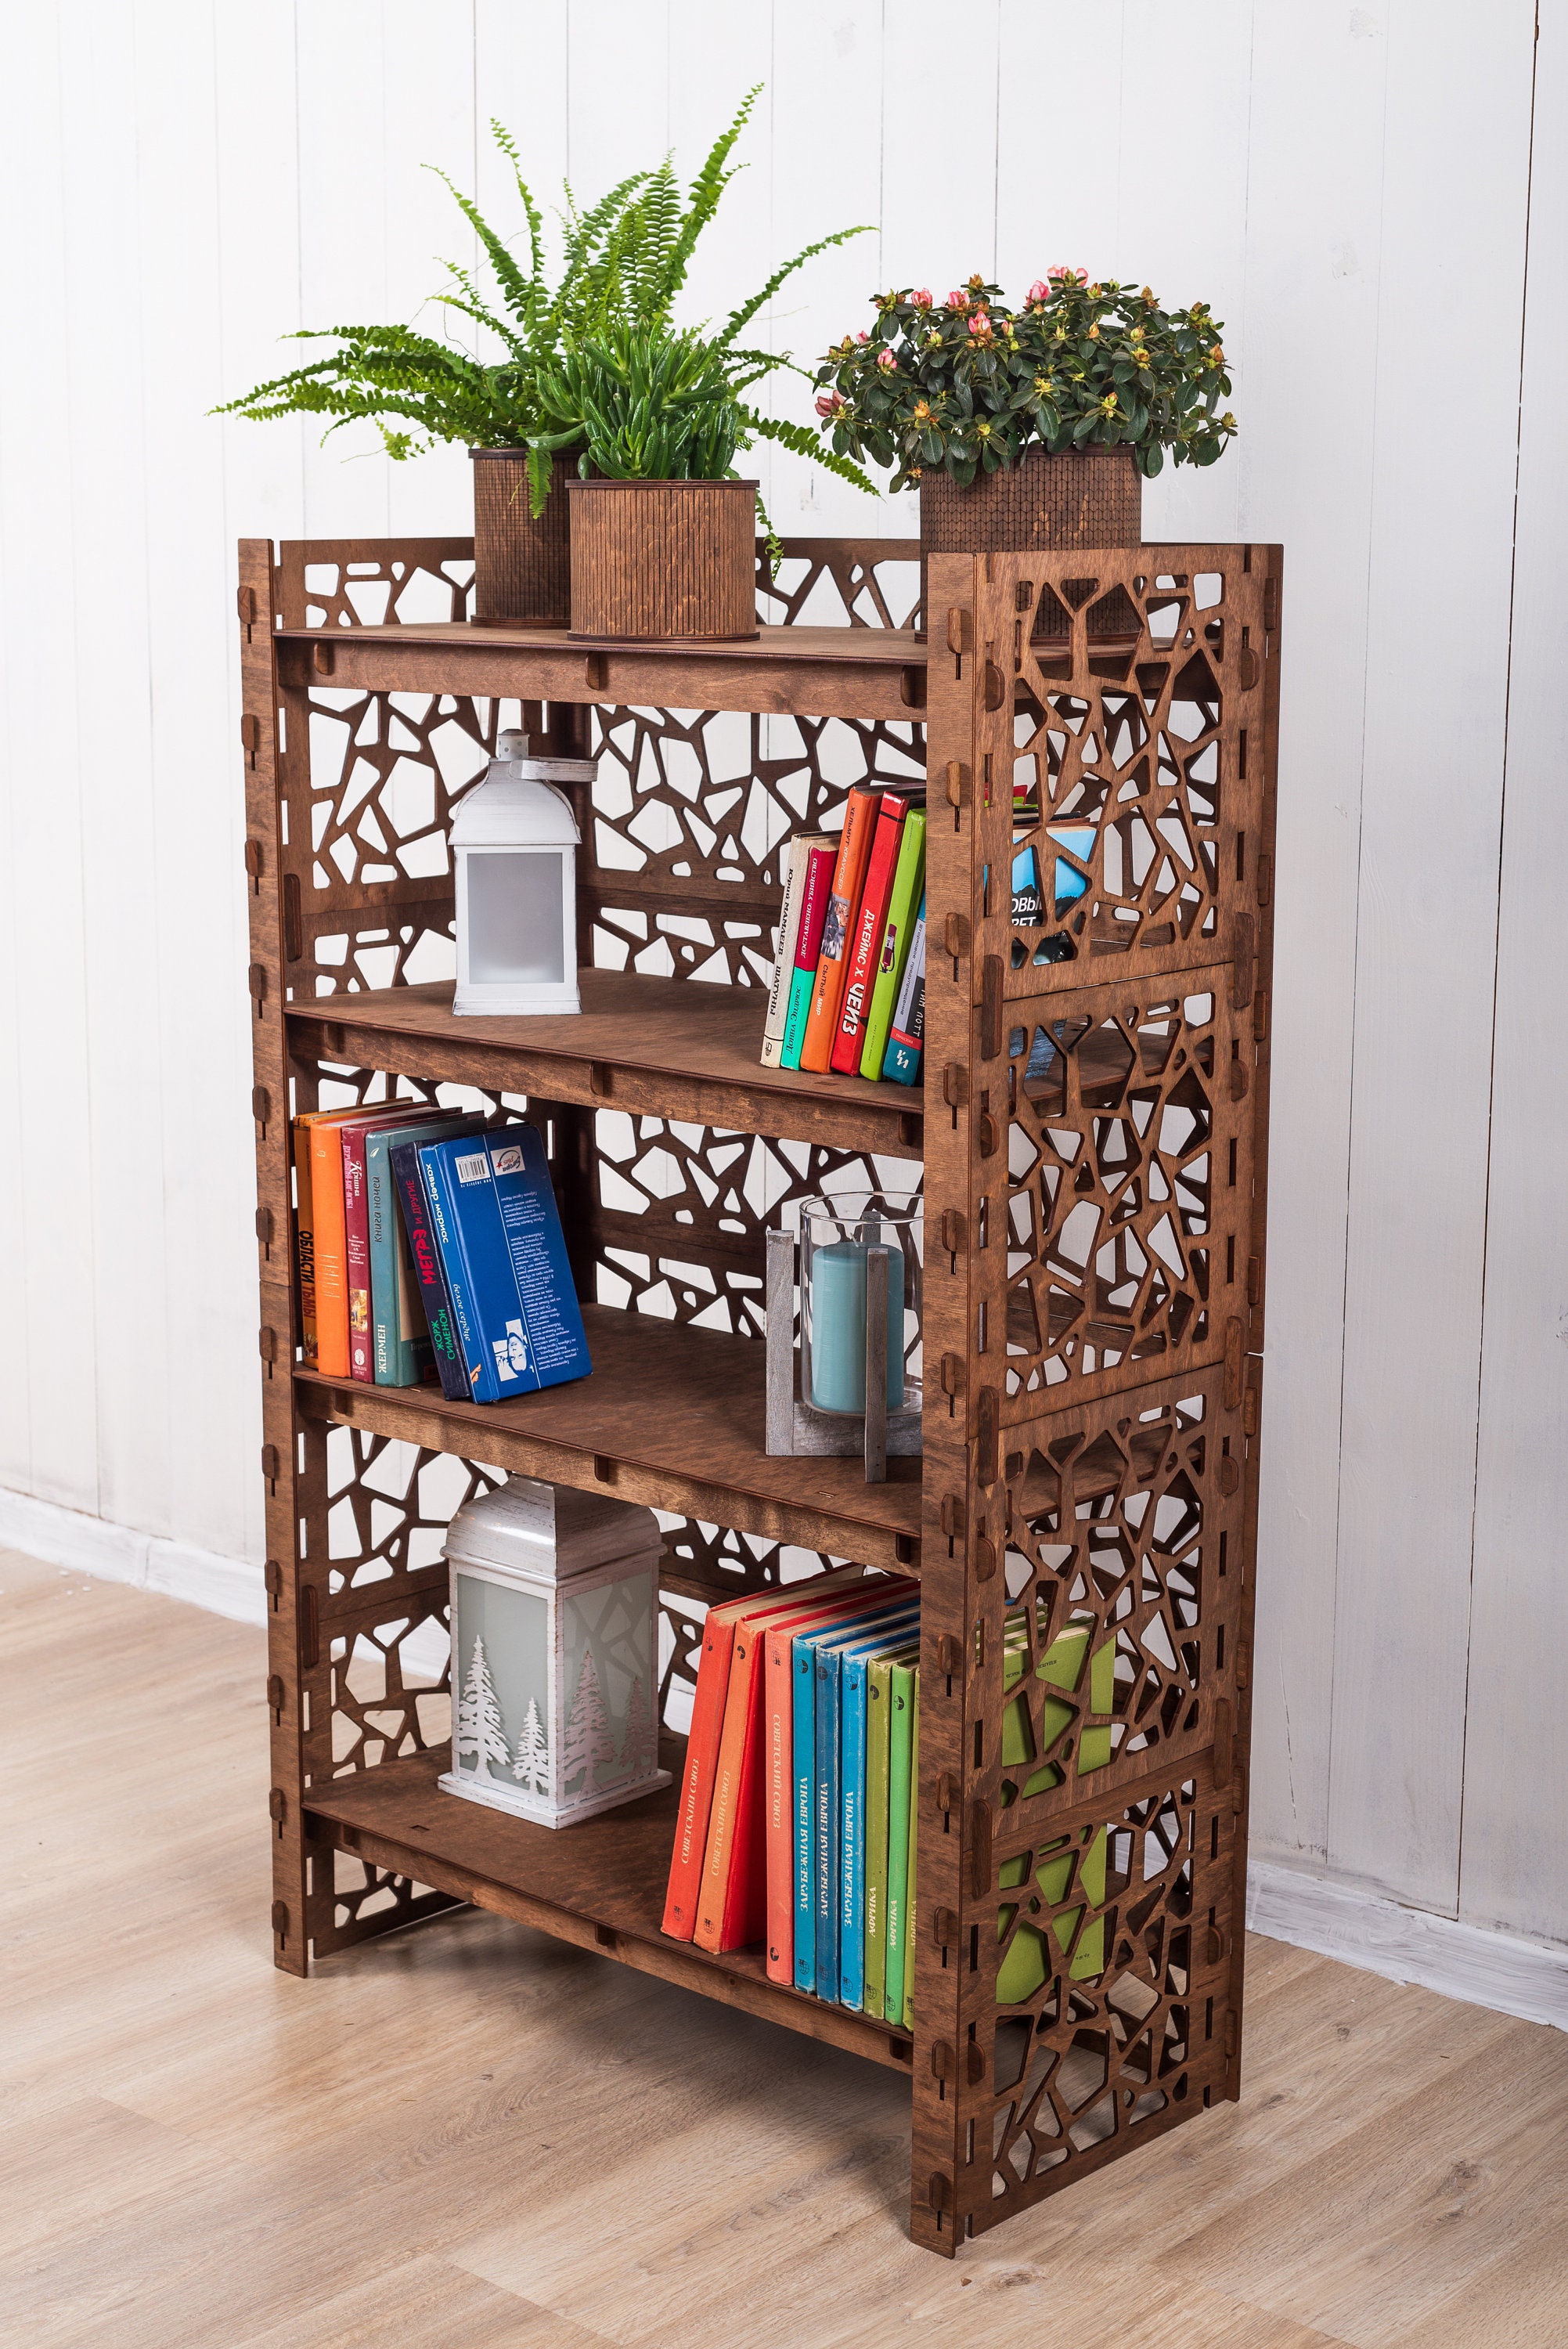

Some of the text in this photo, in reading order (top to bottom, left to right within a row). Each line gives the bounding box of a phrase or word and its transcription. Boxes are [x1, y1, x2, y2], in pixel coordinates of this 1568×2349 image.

[838, 806, 855, 890] ХЕЛЬМУТ КРАУССЕР
[801, 857, 818, 958] ДОСТАВЛЕНО: УБИЙСТВО
[857, 909, 875, 965] ДЖЕЙМС
[770, 868, 794, 1016] Юрий МАМЛЕЕВ ШАТУНЫ
[818, 964, 829, 997] СЫТЫЙ
[900, 962, 914, 1016] предупреждение
[786, 986, 802, 1055] Донна Эндрюс
[913, 1011, 924, 1037] ЛОТТ
[350, 1160, 362, 1196] Крішна
[406, 1180, 422, 1214] ДРУГИЕ
[425, 1164, 449, 1244] хавьер мариас
[299, 1230, 315, 1319] ОБЛАСТИ ТЬМЫ
[413, 1229, 437, 1285] МЕГРЭ
[431, 1320, 445, 1351] ЖОРЖ
[438, 1308, 456, 1360] СИМЕНОН
[452, 1283, 471, 1341] белое сердце
[377, 1324, 387, 1373] ЖЕРМЕН
[773, 1714, 781, 1829] СОВЕТСКИЙ СОЮЗ
[681, 1759, 700, 1864] СОВЕТСКИЙ СОЮЗ
[711, 1807, 726, 1877] СОВЕТСКИЙ
[800, 1777, 809, 1913] ЗАРУБЕЖНАЯ ЕВРОПА
[844, 1791, 854, 1929] ЗАРУБЕЖНАЯ ЕВРОПА
